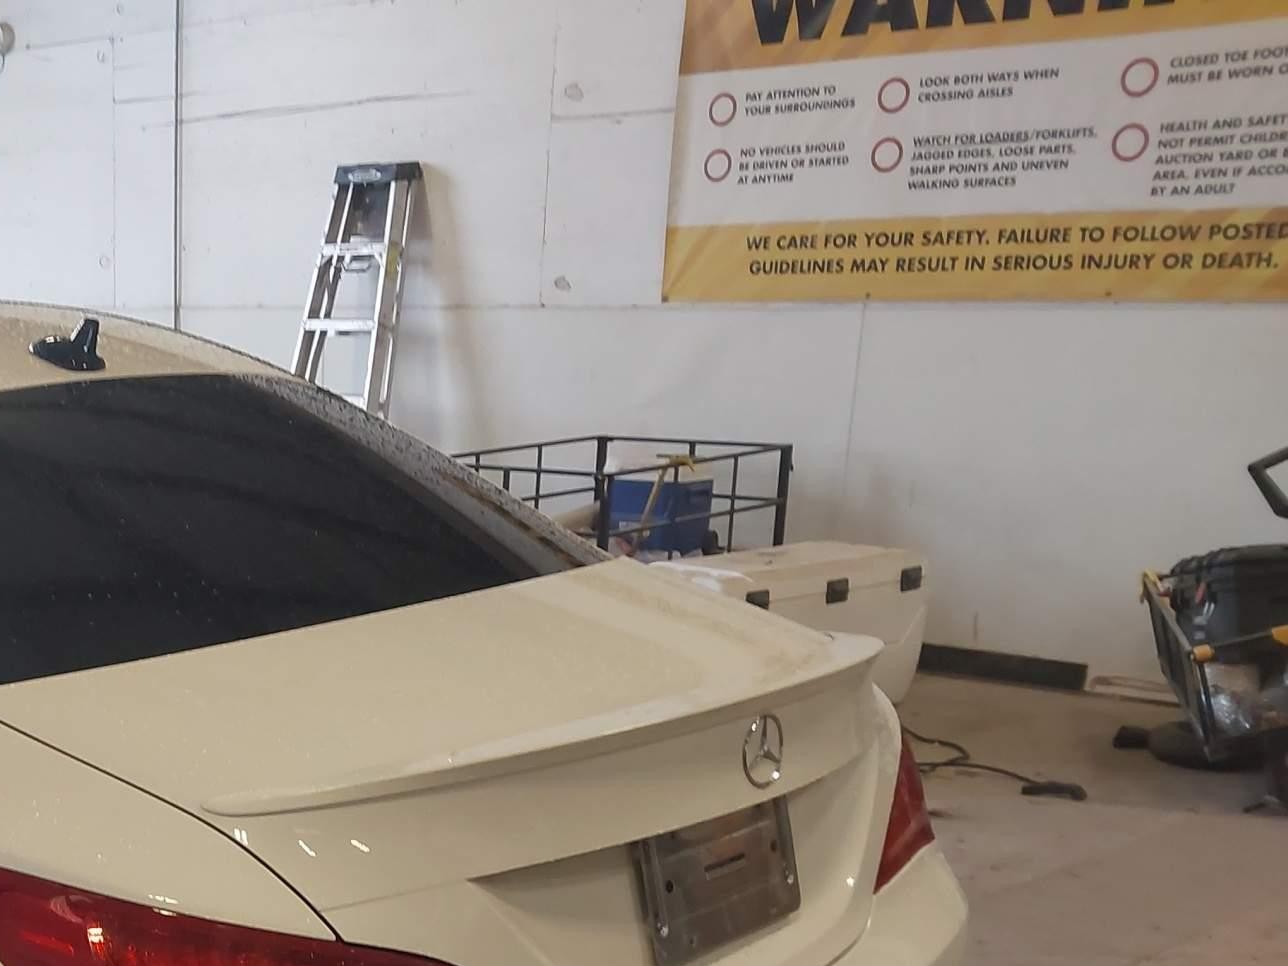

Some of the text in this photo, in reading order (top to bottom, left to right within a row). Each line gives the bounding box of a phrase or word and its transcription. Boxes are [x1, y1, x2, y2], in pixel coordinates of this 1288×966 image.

[1170, 53, 1219, 69] CLOSED
[1225, 51, 1248, 63] TOE
[919, 68, 1060, 88] LOOK BOTH WAYS WHEN
[1167, 72, 1203, 85] MUST
[1207, 70, 1223, 82] BE
[1228, 66, 1274, 80] WORN
[745, 85, 836, 102] PAY ATTENTION TO
[918, 87, 1014, 103] CROSSING AISLES
[745, 97, 855, 117] YOUR SURROUNDINGS
[1160, 119, 1208, 134] HEALTH
[1212, 118, 1242, 129] AND
[913, 135, 951, 147] WATCH
[954, 134, 975, 145] FOR
[1158, 138, 1185, 149] NOT
[1189, 134, 1235, 147] PERMIT
[740, 141, 845, 158] NO VEHICLES SHOULD
[912, 150, 954, 161] JAGGED
[999, 145, 1035, 157] LOOSE
[1155, 152, 1213, 165] AUCTION
[1219, 150, 1253, 161] YARD
[1258, 148, 1278, 160] OR
[739, 156, 849, 171] BE DRIVEN OR STARTED
[910, 159, 1069, 176] SHARP POINTS AND UNEVEN
[1194, 167, 1227, 179] EVEN
[1232, 166, 1243, 177] IF
[1248, 163, 1288, 176] ACCO
[737, 173, 794, 185] AT ANYTIME
[908, 176, 1016, 190] WALKING SURFACES
[1151, 182, 1236, 197] BY AN ADULT
[746, 222, 1288, 251] WE CARE FOR YOUR SAFETY. FAILURE TO FOLLOW POSTED
[749, 252, 1279, 275] GUIDELINES MAY RESULT IN SERIOUS INJURY OR DEATH.
